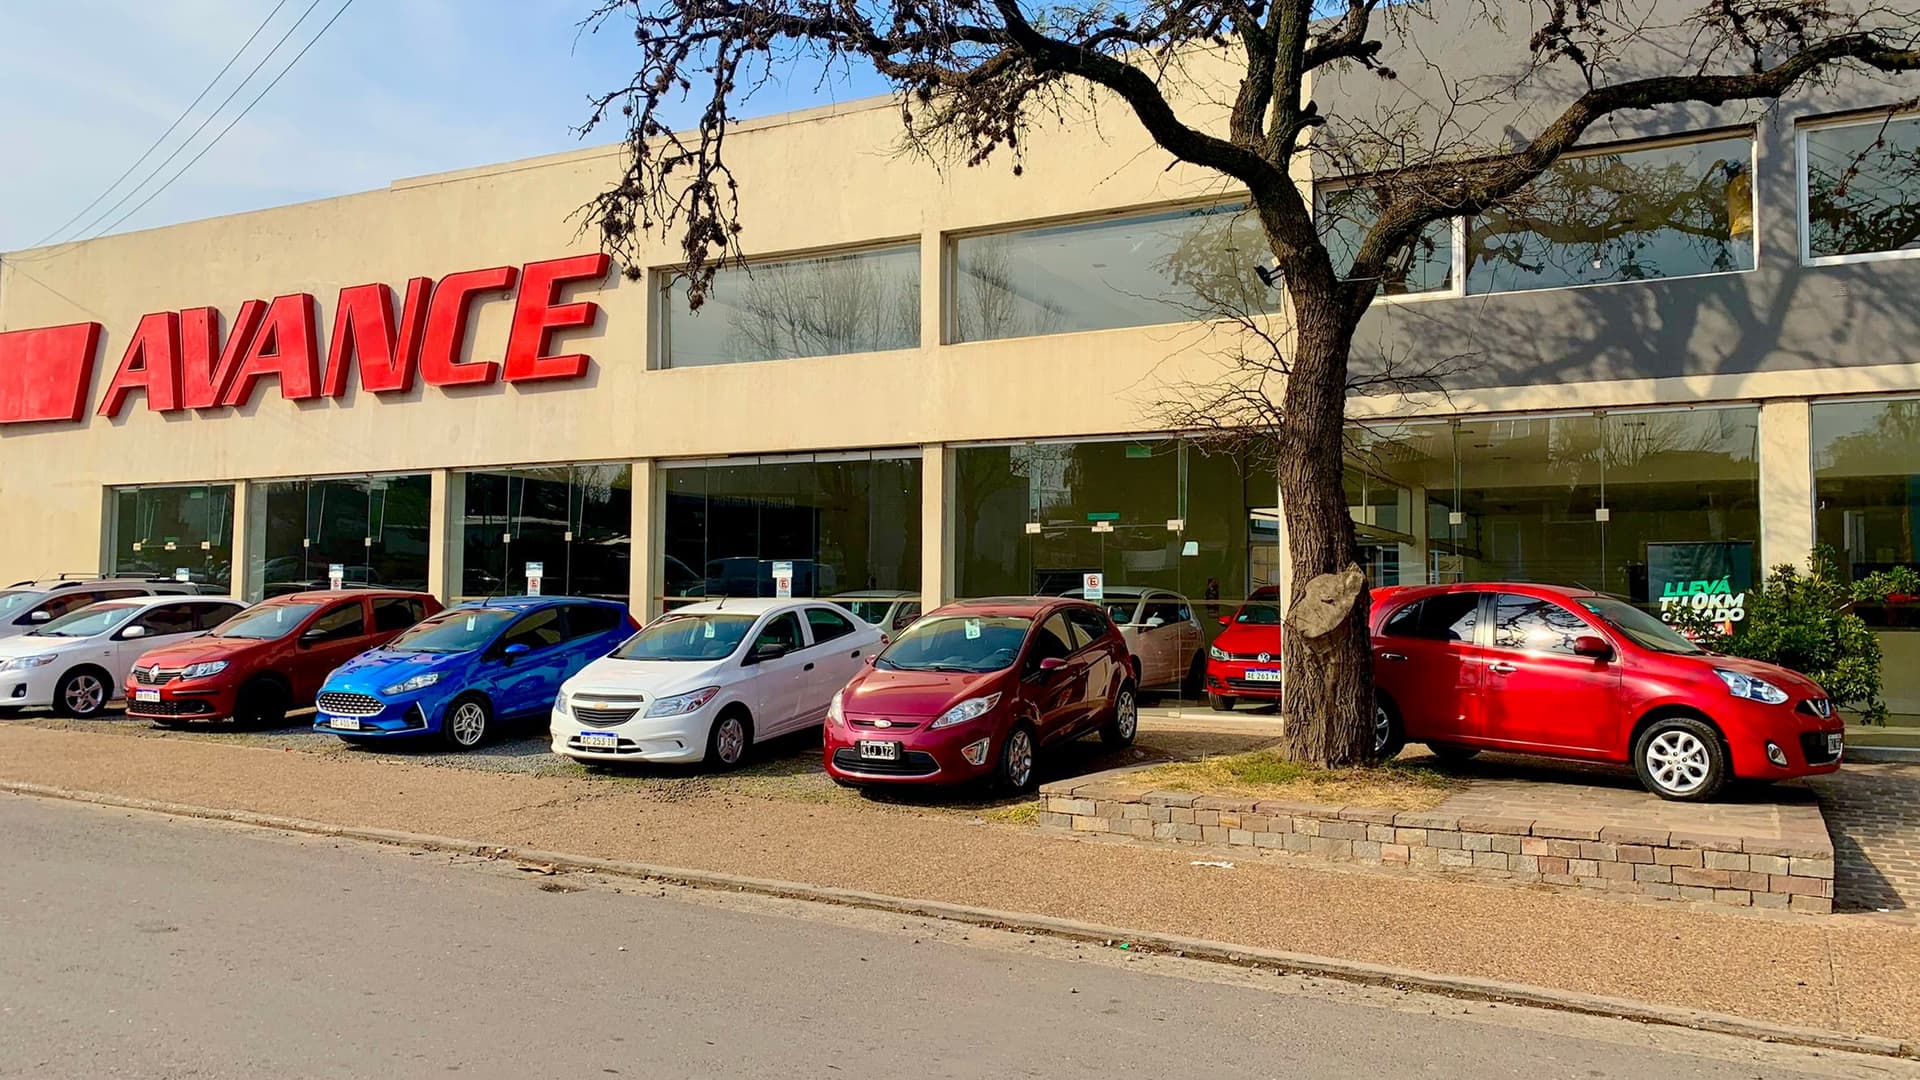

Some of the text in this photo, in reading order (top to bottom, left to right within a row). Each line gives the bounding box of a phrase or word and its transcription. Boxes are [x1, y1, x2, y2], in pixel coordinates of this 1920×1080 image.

[97, 253, 609, 417] AVANCE
[1663, 575, 1731, 597] LLEVÁ
[592, 737, 606, 746] 253
